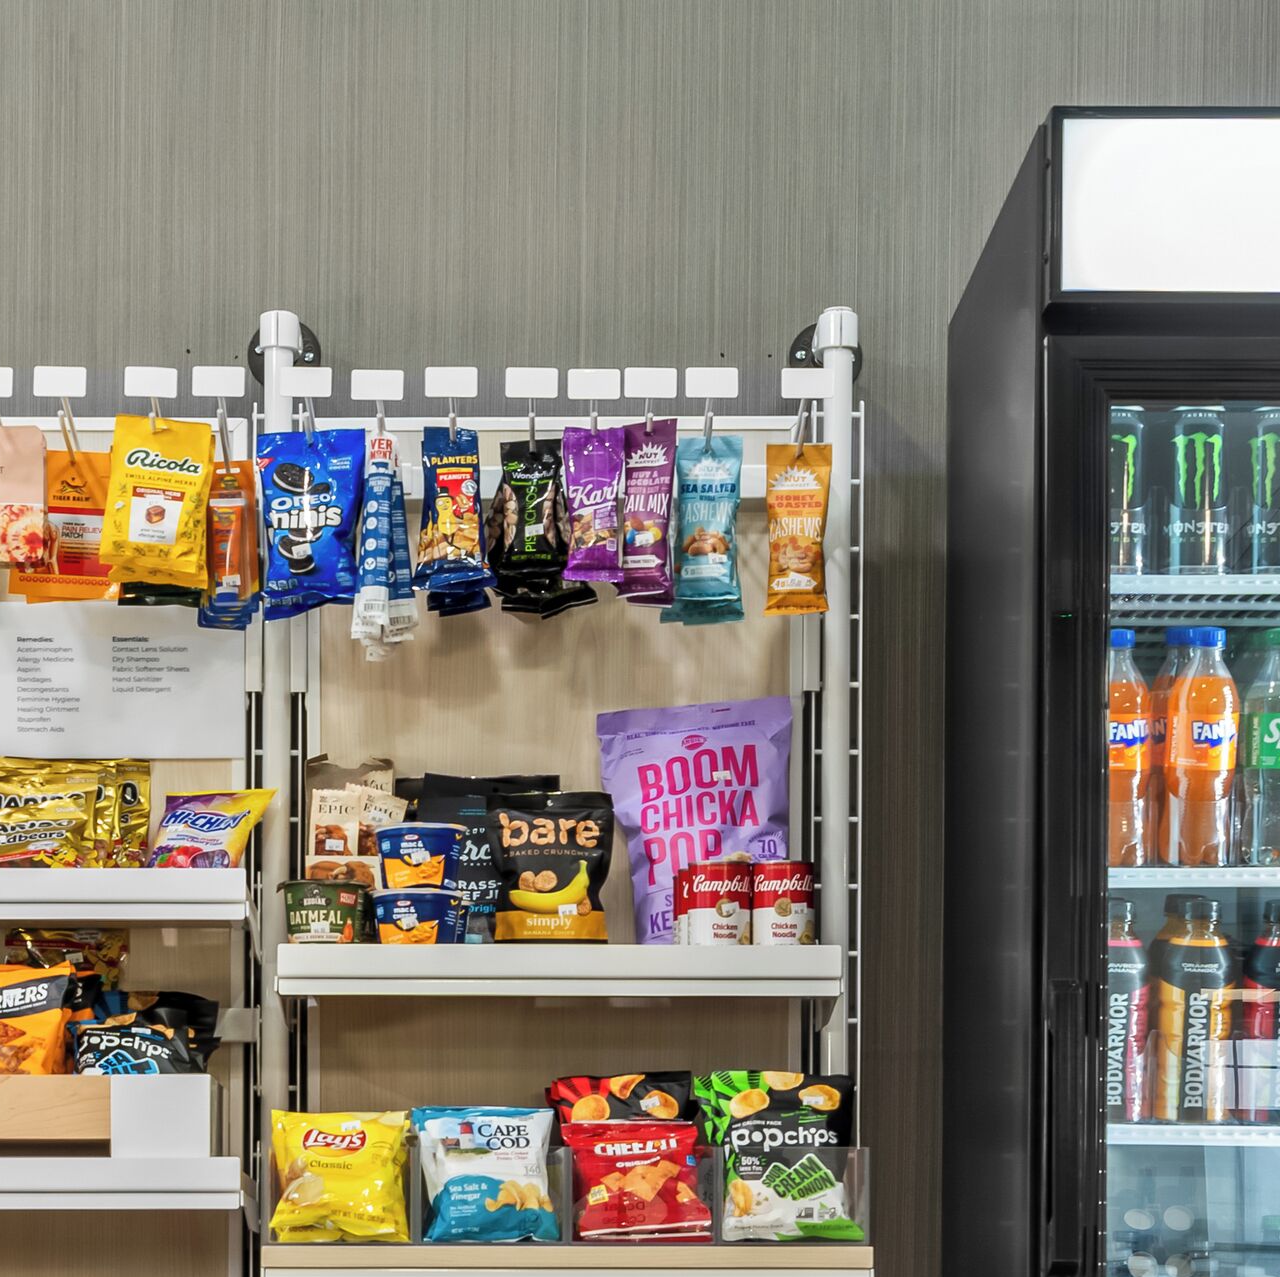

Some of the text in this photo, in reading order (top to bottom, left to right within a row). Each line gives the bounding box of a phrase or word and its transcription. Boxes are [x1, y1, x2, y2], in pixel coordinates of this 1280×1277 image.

[431, 455, 477, 466] PLANTERS
[638, 451, 658, 460] NUT
[127, 449, 200, 474] Ricola
[148, 476, 172, 484] ALPINE
[439, 473, 471, 482] PEANUTS
[512, 470, 554, 481] Wonderful
[784, 475, 806, 483] NUT
[136, 488, 163, 496] ORIGINAL
[681, 483, 736, 494] SEA SALTED
[775, 494, 816, 502] HONEY
[650, 493, 669, 517] MIX
[770, 501, 822, 509] ROASTED
[770, 517, 822, 541] CASHEWS
[17, 646, 73, 654] Acetaminophen
[17, 656, 41, 664] Allergy
[126, 656, 160, 664] Shampoo
[17, 666, 41, 674] Aspirin
[112, 686, 171, 694] Liquid Detergent
[17, 716, 52, 724] Ibuprofen
[637, 744, 760, 804] BOOM
[318, 804, 352, 815] EPIC
[640, 790, 760, 835] CHICKA
[499, 813, 600, 848] bare
[757, 839, 777, 856] 70
[509, 850, 540, 858] BAKED
[643, 828, 723, 887] POP
[290, 910, 343, 926] OATMEAL
[527, 913, 572, 927] simply
[712, 923, 738, 931] Chicken
[771, 922, 797, 931] Chicken
[713, 931, 737, 939] Noodle
[772, 931, 796, 939] Noodle
[1107, 992, 1128, 1106] BODYARMOR
[1184, 992, 1209, 1108] BODYARMOR
[99, 1049, 134, 1071] SEA
[477, 1123, 529, 1137] CAPE
[304, 1128, 366, 1149] Lay's
[486, 1136, 530, 1150] COD
[731, 1126, 838, 1153] popchips
[309, 1160, 353, 1170] Classic
[616, 1156, 661, 1168] ORIGINAL
[762, 1163, 790, 1188] SOUR
[773, 1156, 821, 1200] CREAM
[798, 1172, 835, 1199] ONION
[450, 1191, 481, 1201] Vinegar
